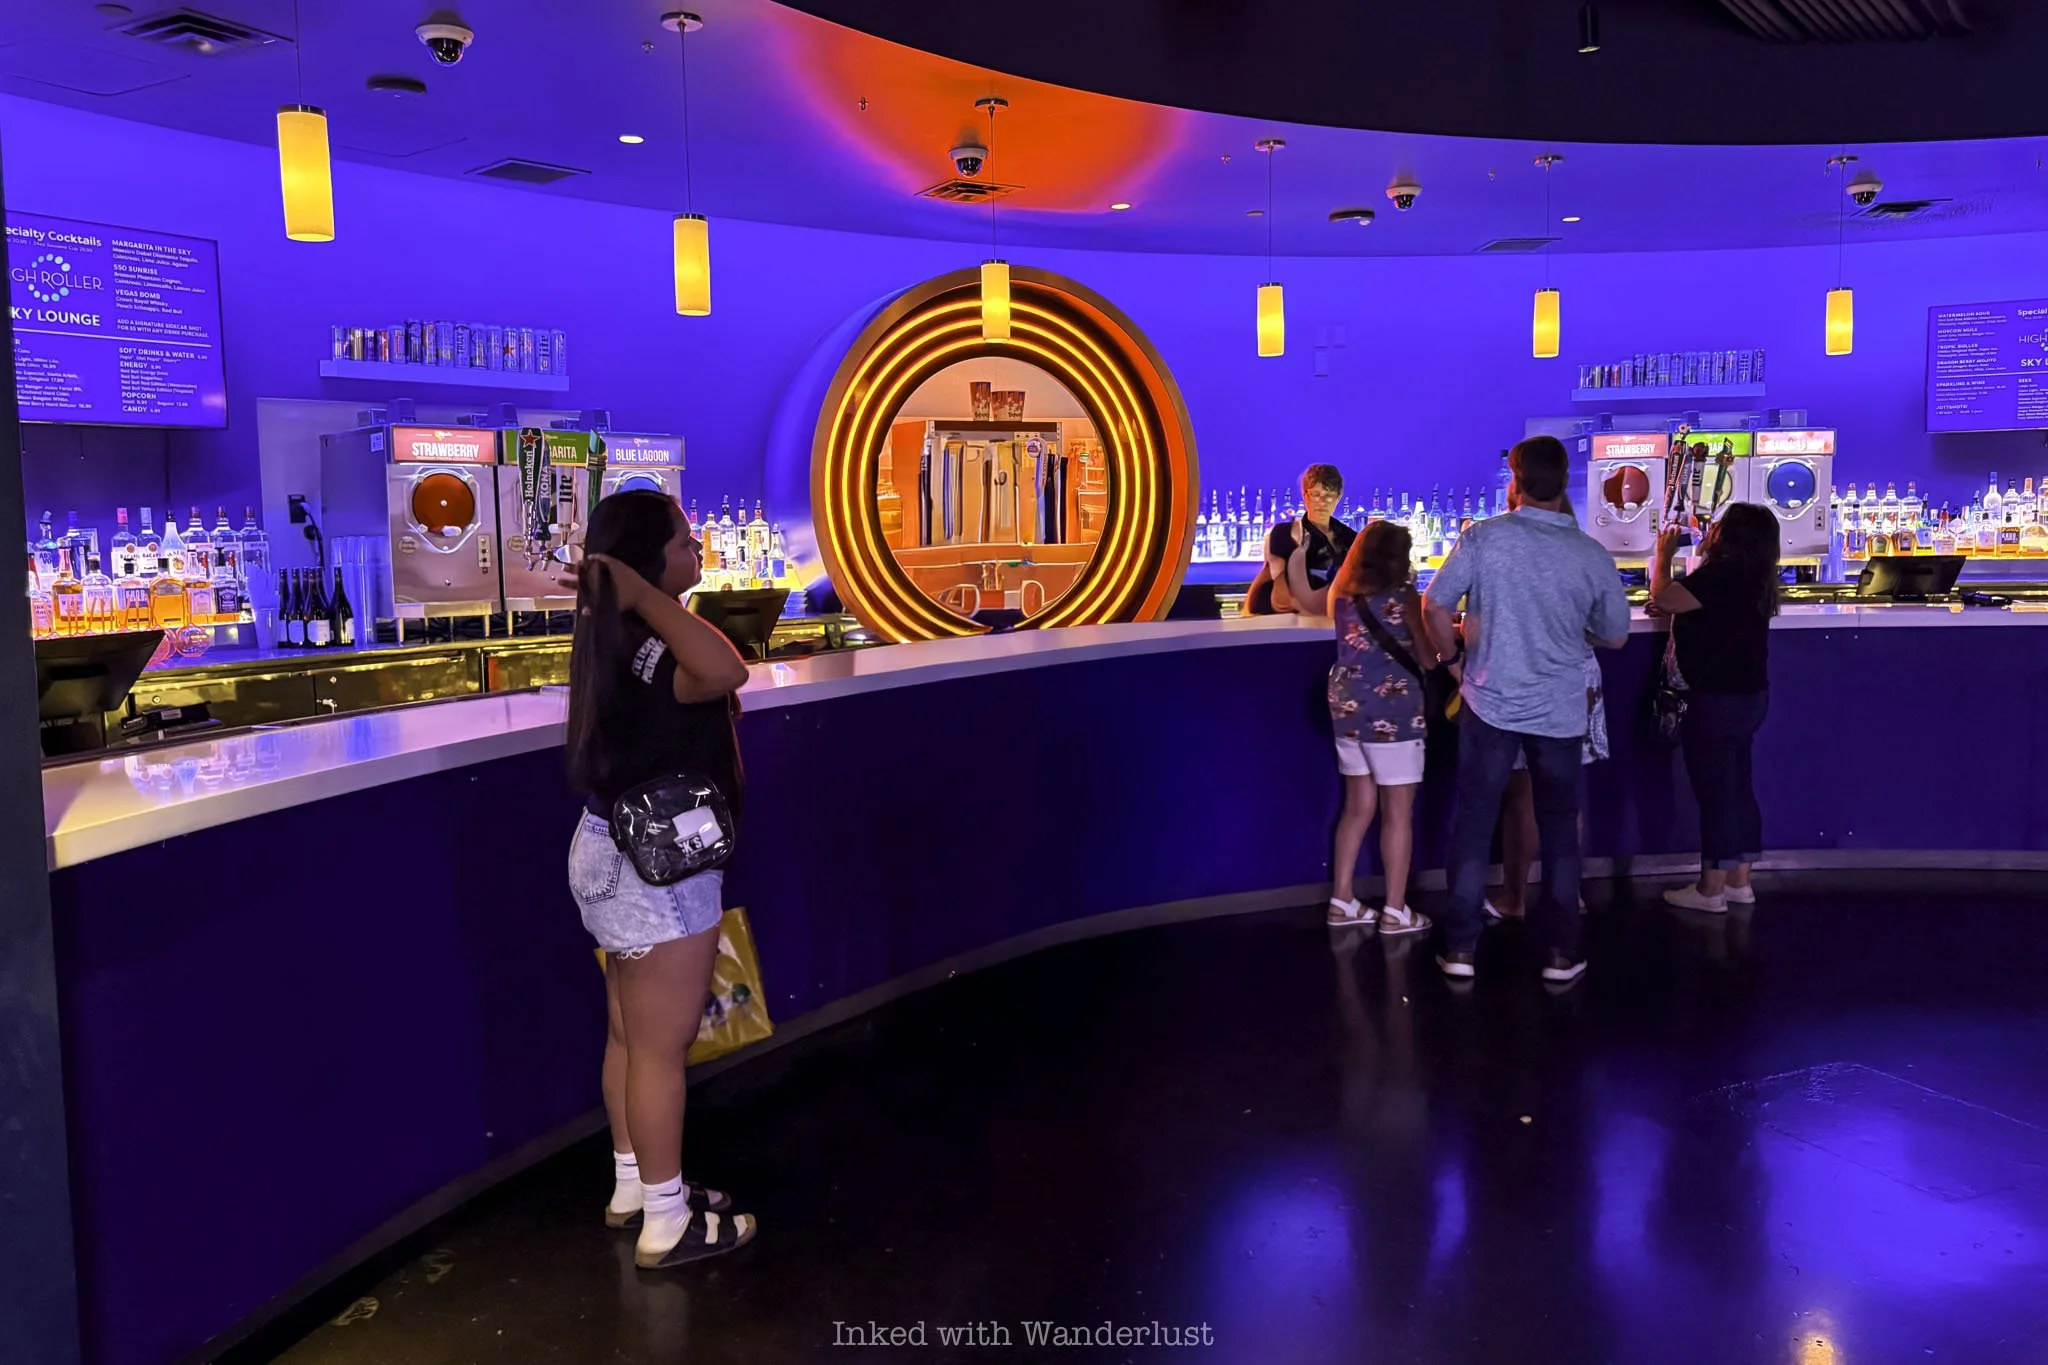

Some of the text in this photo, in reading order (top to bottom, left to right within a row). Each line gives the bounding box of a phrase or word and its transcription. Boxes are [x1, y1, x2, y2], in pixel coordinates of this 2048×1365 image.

[48, 231, 102, 247] Cocktails
[112, 239, 154, 251] MARGARITA
[164, 246, 177, 254] THE
[177, 248, 192, 256] SKY
[128, 265, 158, 275] SUNRISE
[41, 271, 102, 290] ROLLER
[115, 289, 161, 300] VEGAS BOMB
[37, 309, 101, 326] LOUNGE
[2018, 334, 2048, 343] HIGH
[138, 348, 164, 357] DRINKS
[172, 351, 195, 359] WATER
[120, 361, 148, 369] ENERGY
[2020, 358, 2042, 367] SKY
[122, 405, 147, 413] CANDY
[411, 441, 480, 458] STRAWBERRY
[615, 448, 669, 462] BLUE LAGOON
[1605, 443, 1655, 456] STRAWBERRY
[524, 450, 534, 498] Heineken
[540, 465, 549, 498] KONA
